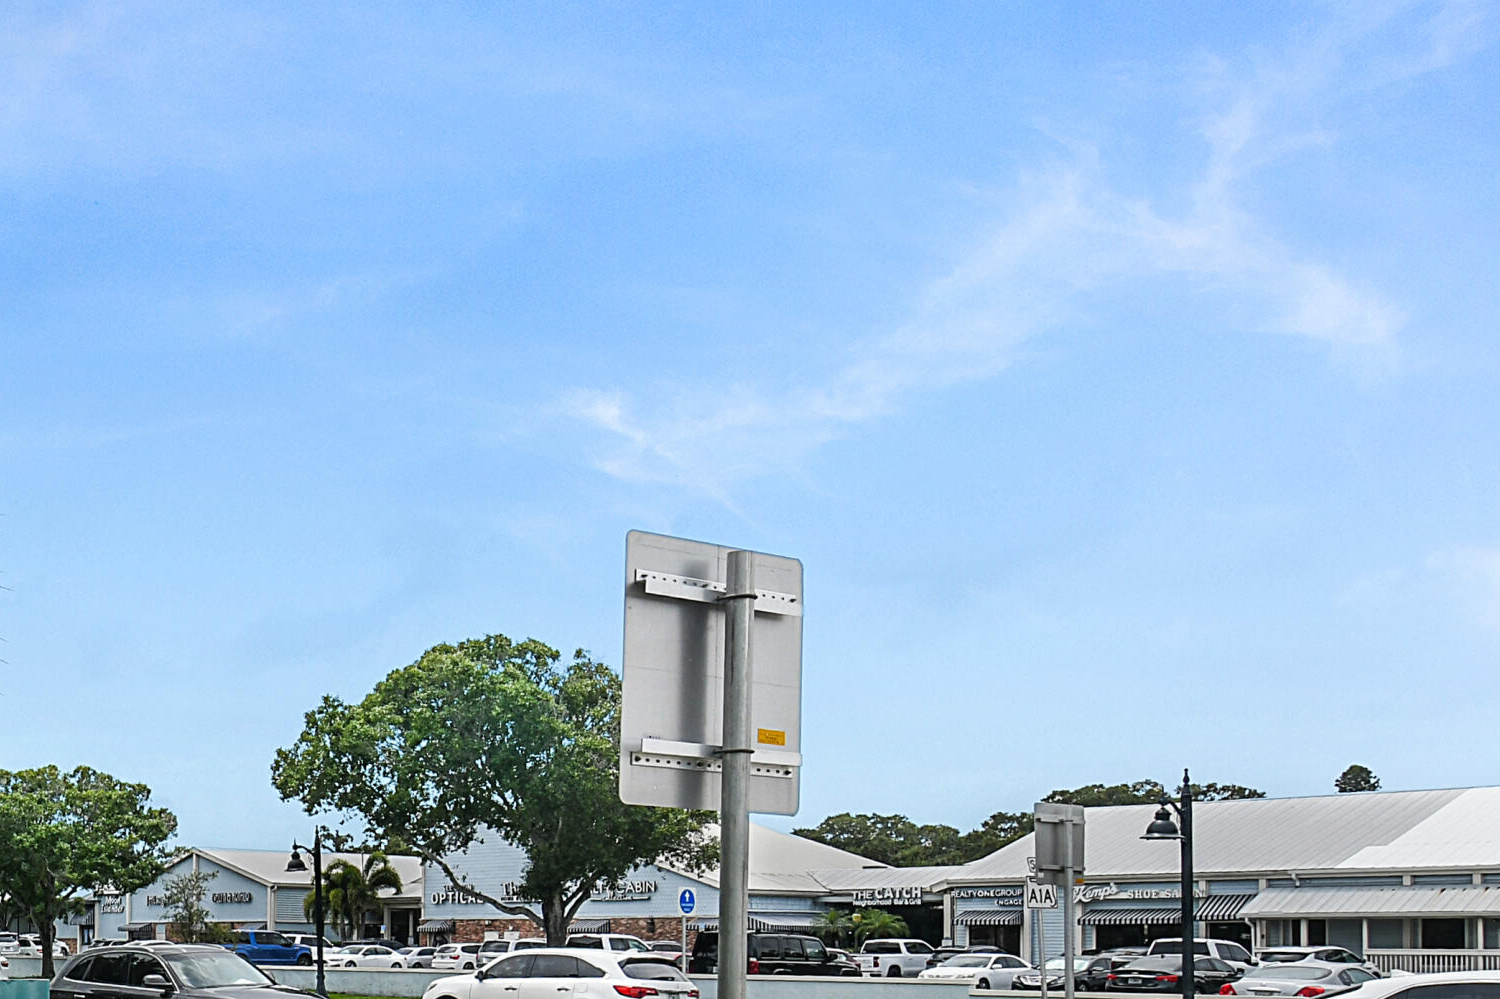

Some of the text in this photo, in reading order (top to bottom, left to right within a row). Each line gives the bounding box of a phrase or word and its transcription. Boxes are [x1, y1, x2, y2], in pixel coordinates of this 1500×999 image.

[615, 880, 658, 894] CABIN
[852, 886, 922, 900] THE CATCH
[1072, 881, 1204, 904] Kemp's SHOE SAN
[1029, 887, 1053, 904] A1A
